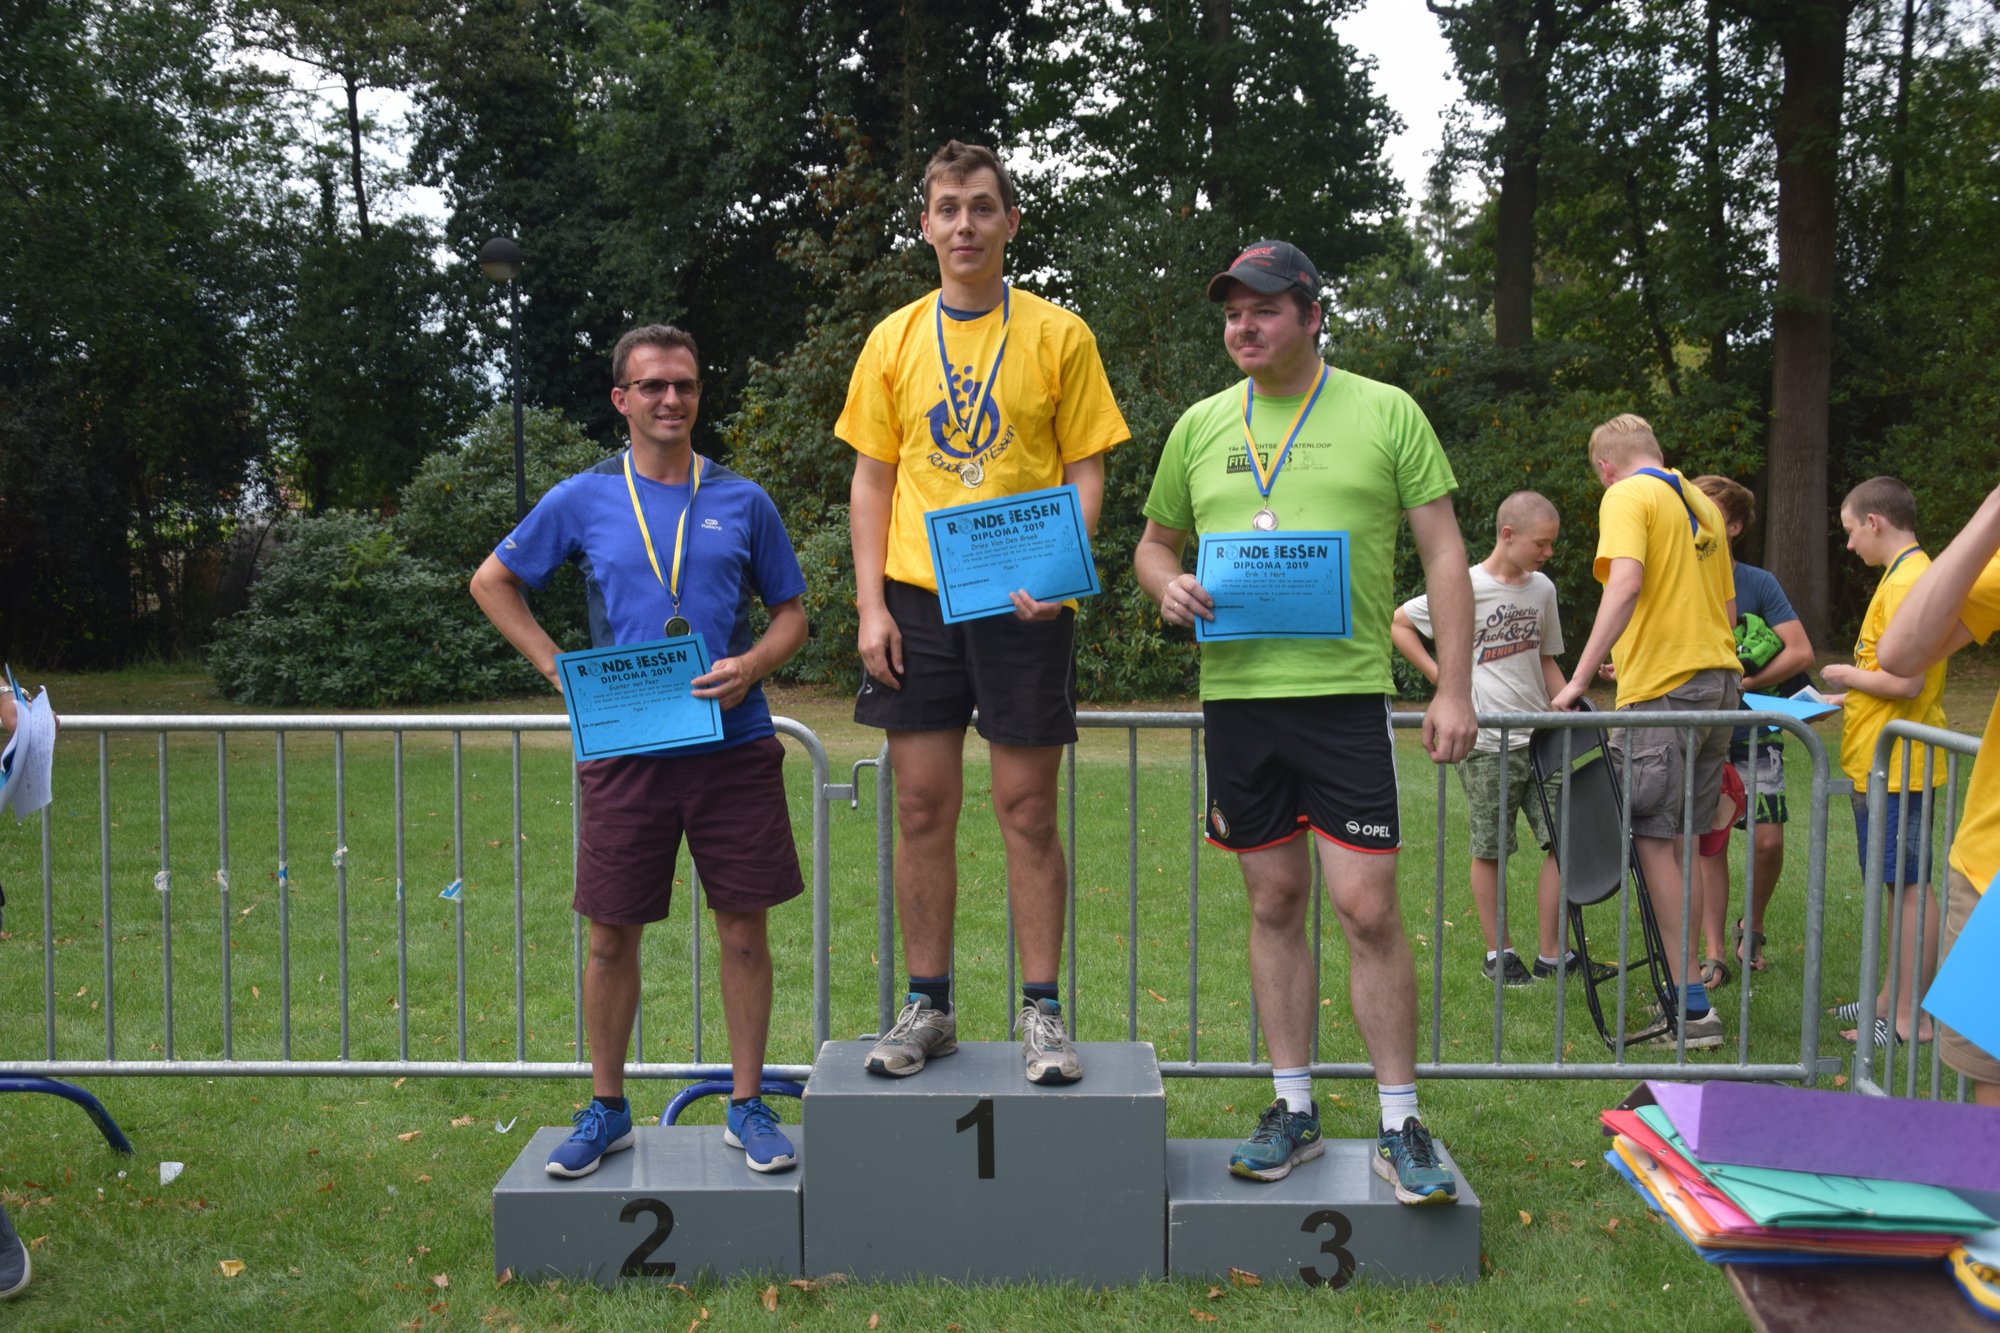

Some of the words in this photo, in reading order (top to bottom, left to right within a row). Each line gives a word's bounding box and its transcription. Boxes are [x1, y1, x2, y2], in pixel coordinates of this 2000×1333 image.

[927, 452, 961, 473] Rond
[1229, 454, 1266, 467] FITLB
[1014, 502, 1060, 522] ESSEN
[971, 526, 1019, 542] DIPLOMA
[1023, 521, 1045, 532] 2019
[1279, 544, 1328, 559] ESSEN
[1233, 561, 1281, 569] DIPLOMA
[1286, 561, 1309, 569] 2019
[641, 650, 688, 668] ESSEN
[601, 670, 648, 684] DIPLOMA
[651, 667, 672, 677] 2019
[1362, 824, 1391, 838] OPEL
[956, 1099, 995, 1179] 1
[619, 1198, 676, 1277] 2
[1299, 1210, 1356, 1290] 3
